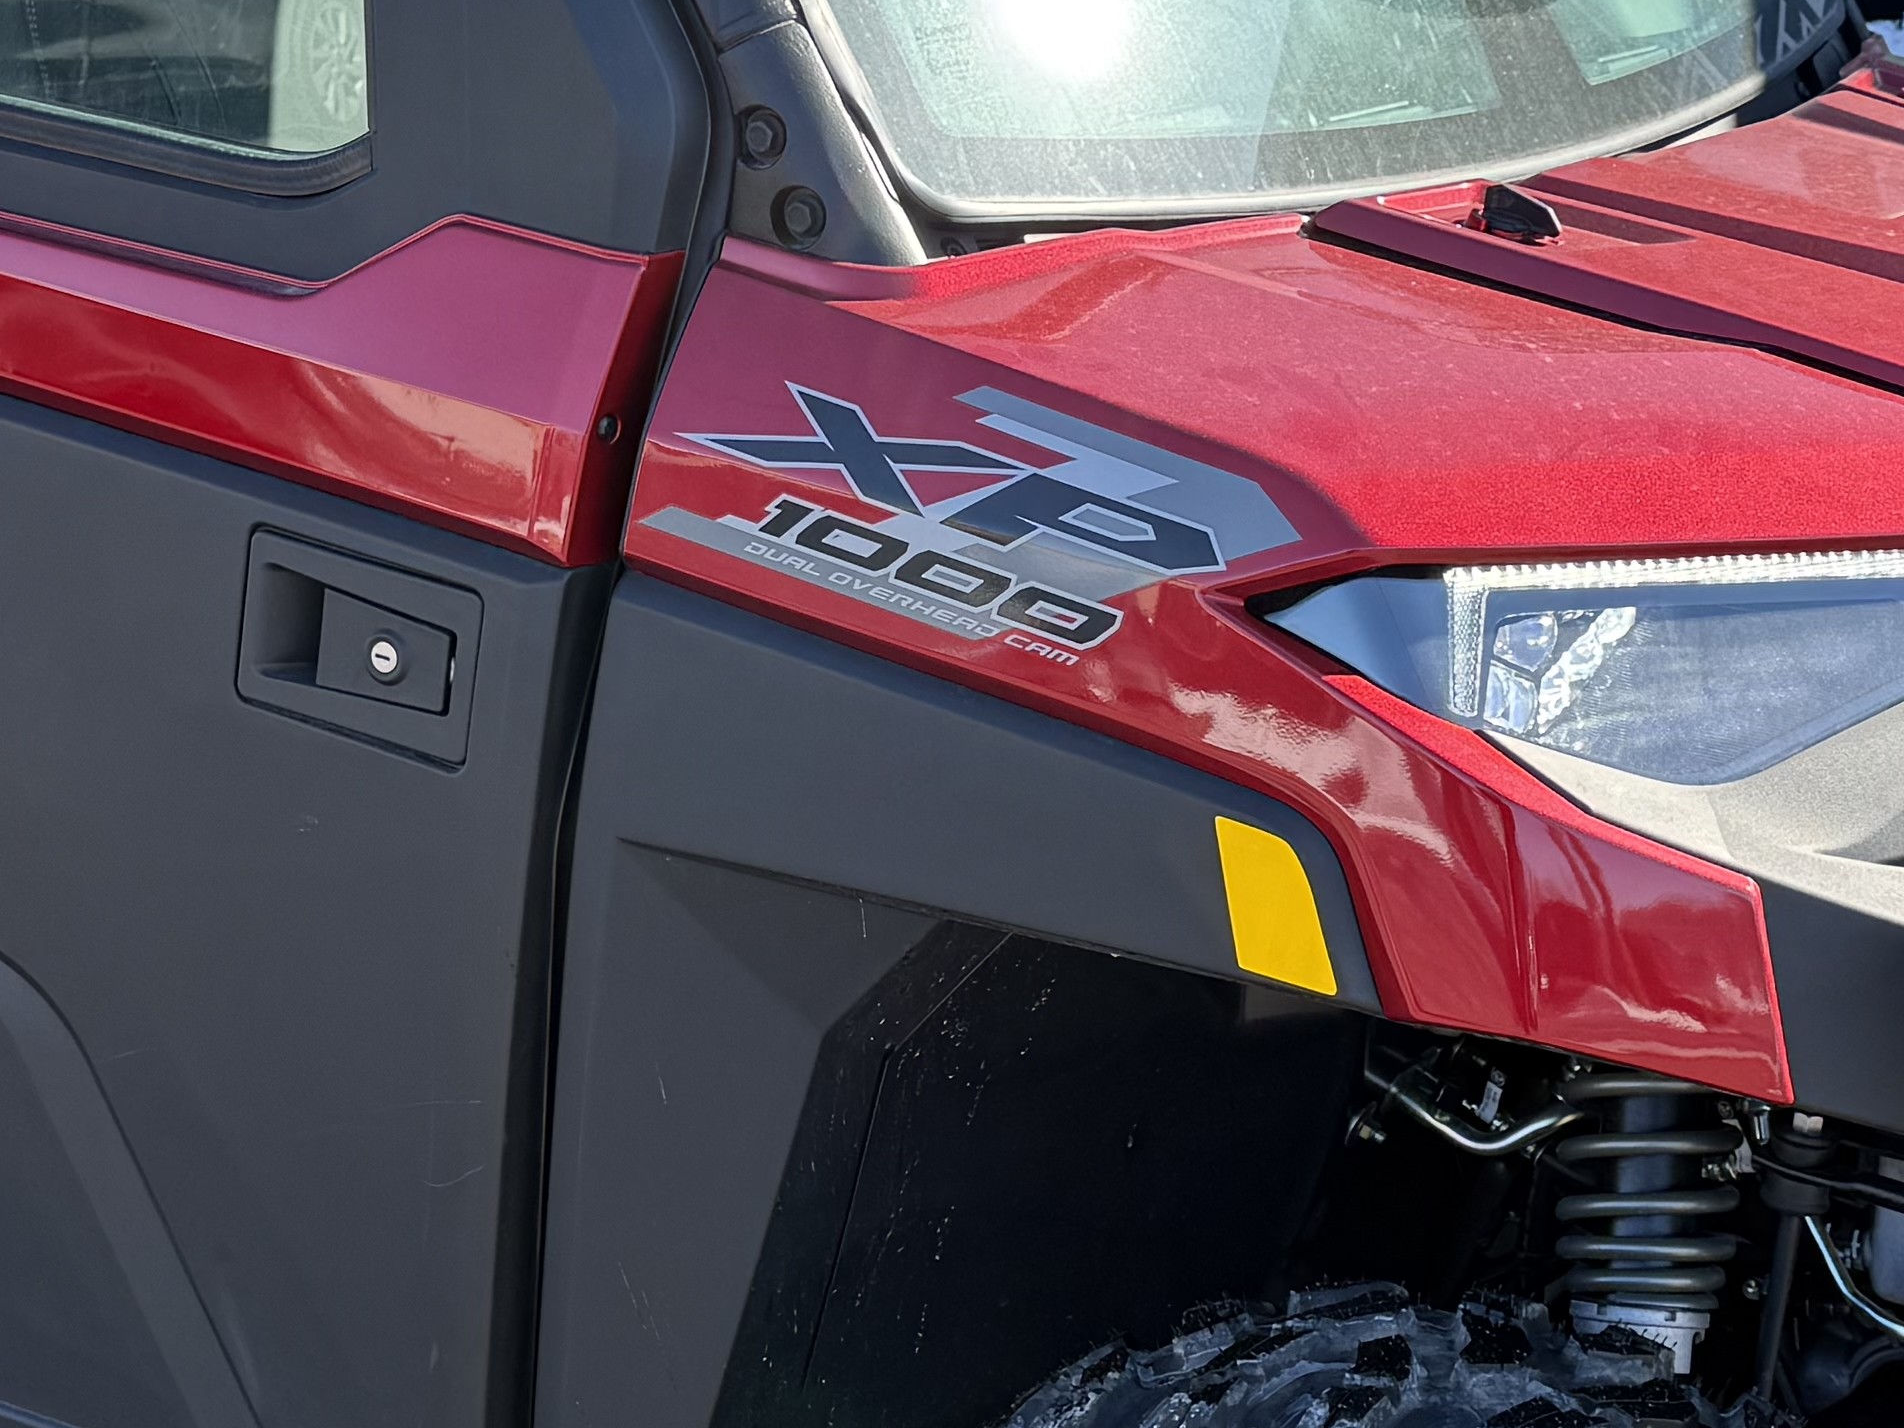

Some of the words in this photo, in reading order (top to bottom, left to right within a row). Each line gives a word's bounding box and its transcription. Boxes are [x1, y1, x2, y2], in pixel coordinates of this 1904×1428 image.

[676, 380, 1227, 573] XP
[743, 541, 820, 577] DUAL
[827, 570, 1000, 638] OVERHEAD
[1003, 633, 1080, 667] CAM
[756, 493, 1125, 651] 1000
